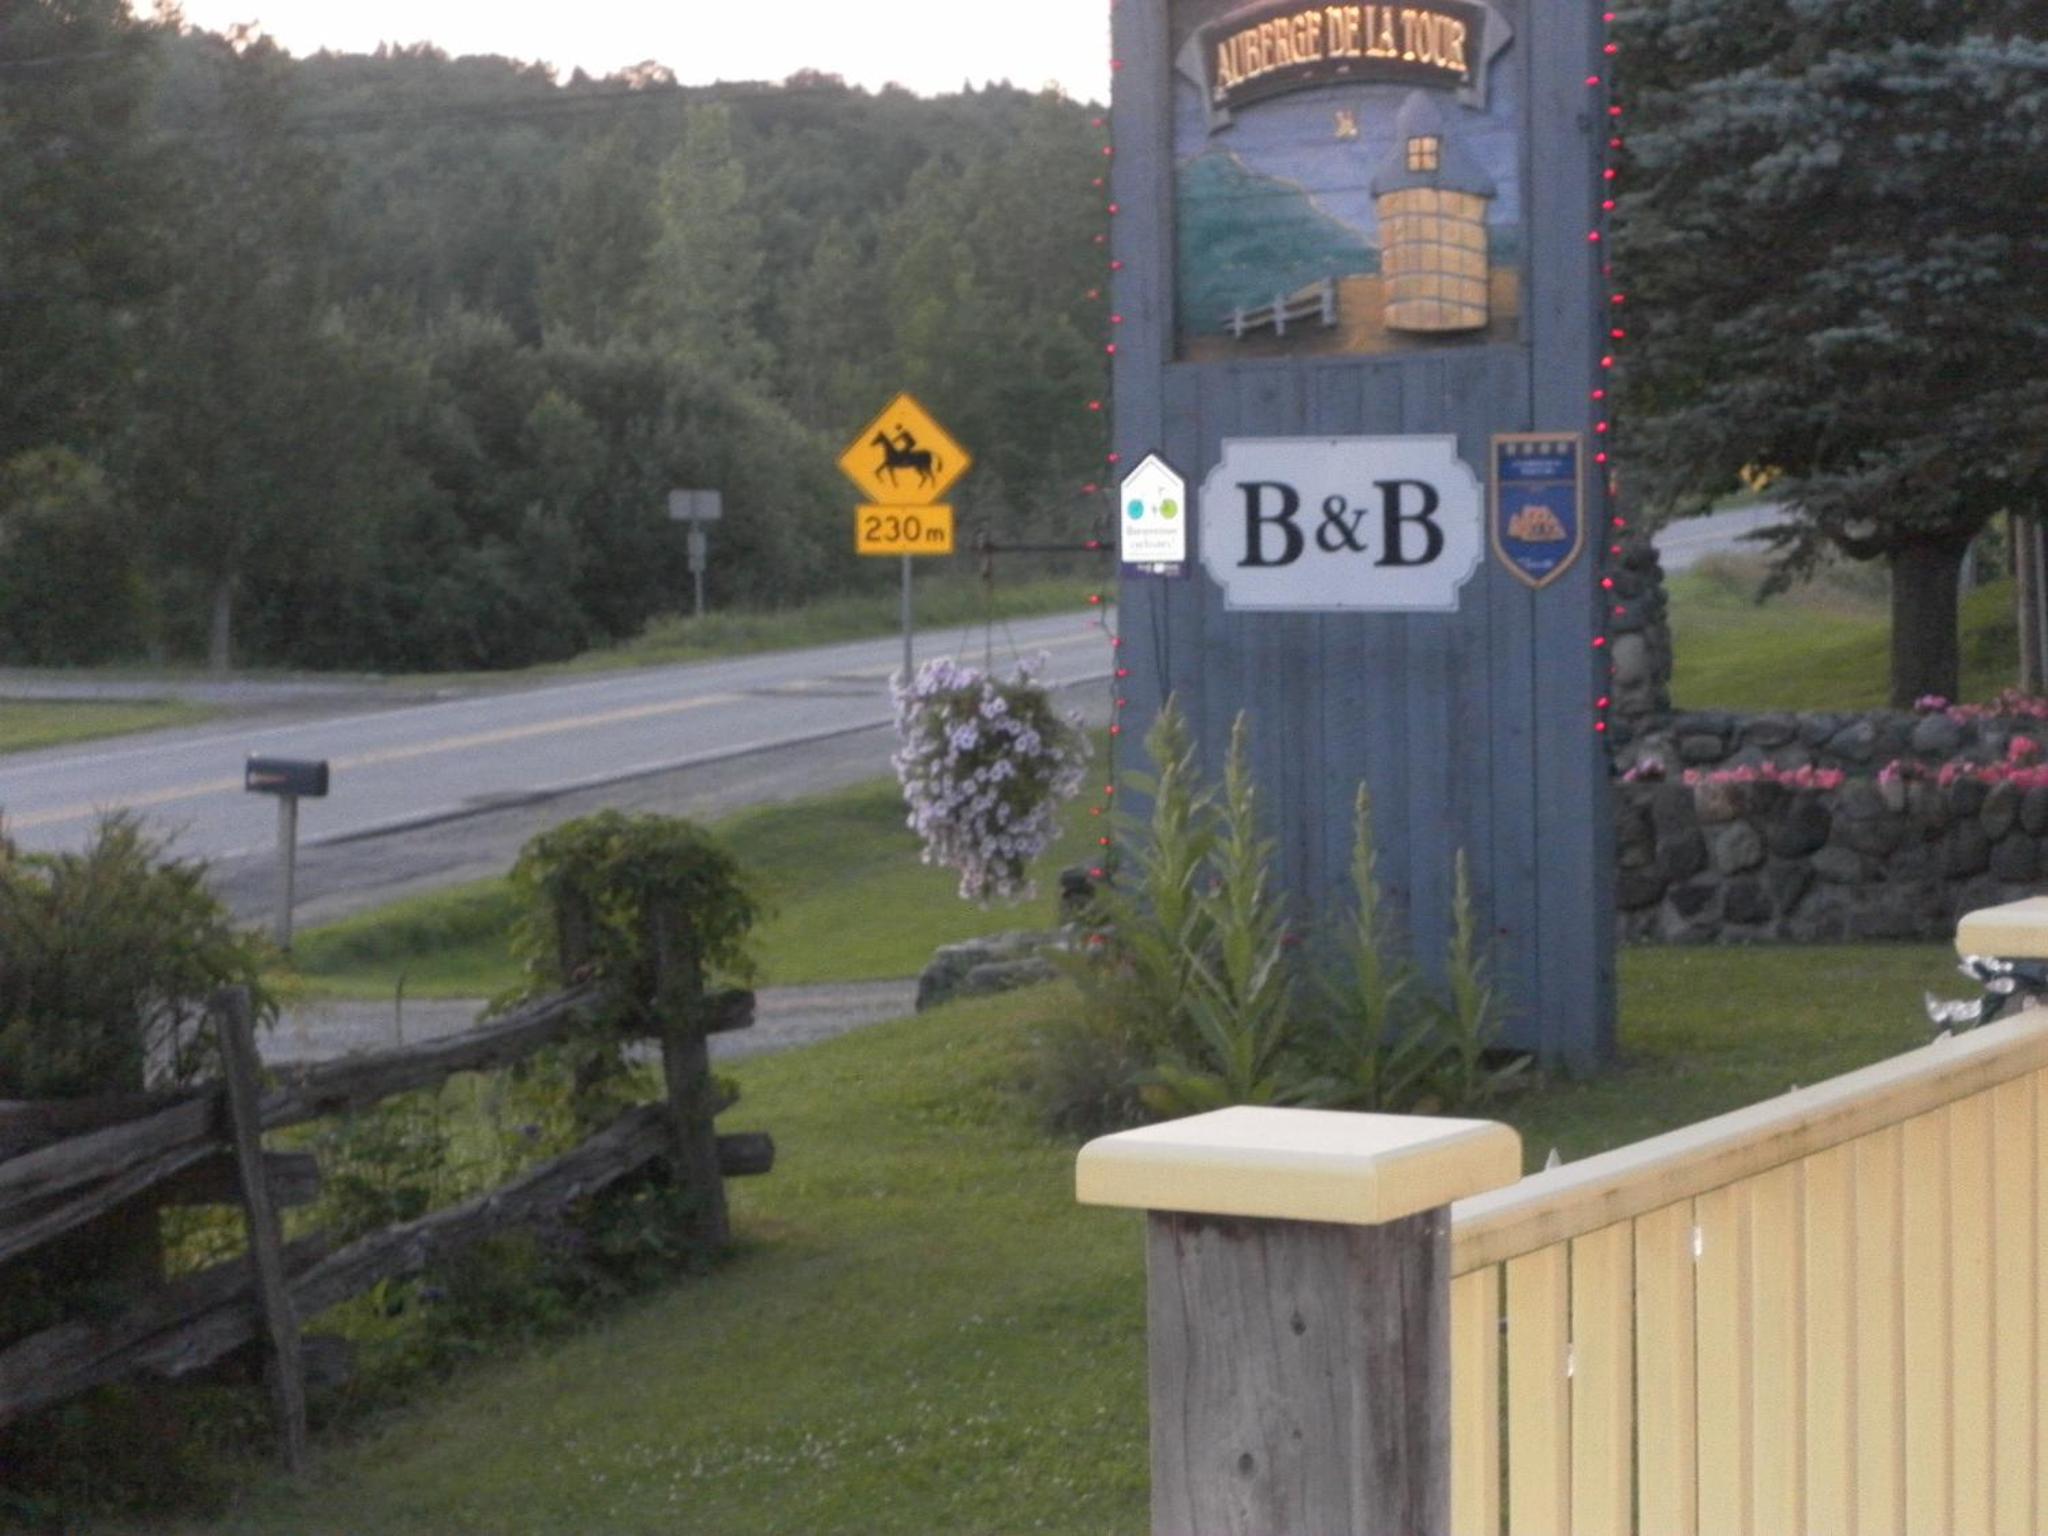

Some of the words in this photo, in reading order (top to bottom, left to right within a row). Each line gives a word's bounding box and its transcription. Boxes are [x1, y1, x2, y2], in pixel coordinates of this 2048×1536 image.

[1216, 10, 1322, 89] AUBERGE
[1325, 6, 1361, 58] DE
[1365, 6, 1398, 58] LA
[1401, 9, 1468, 72] TOUR
[865, 516, 921, 542] 230
[926, 528, 945, 541] m
[1235, 479, 1444, 567] B&B
